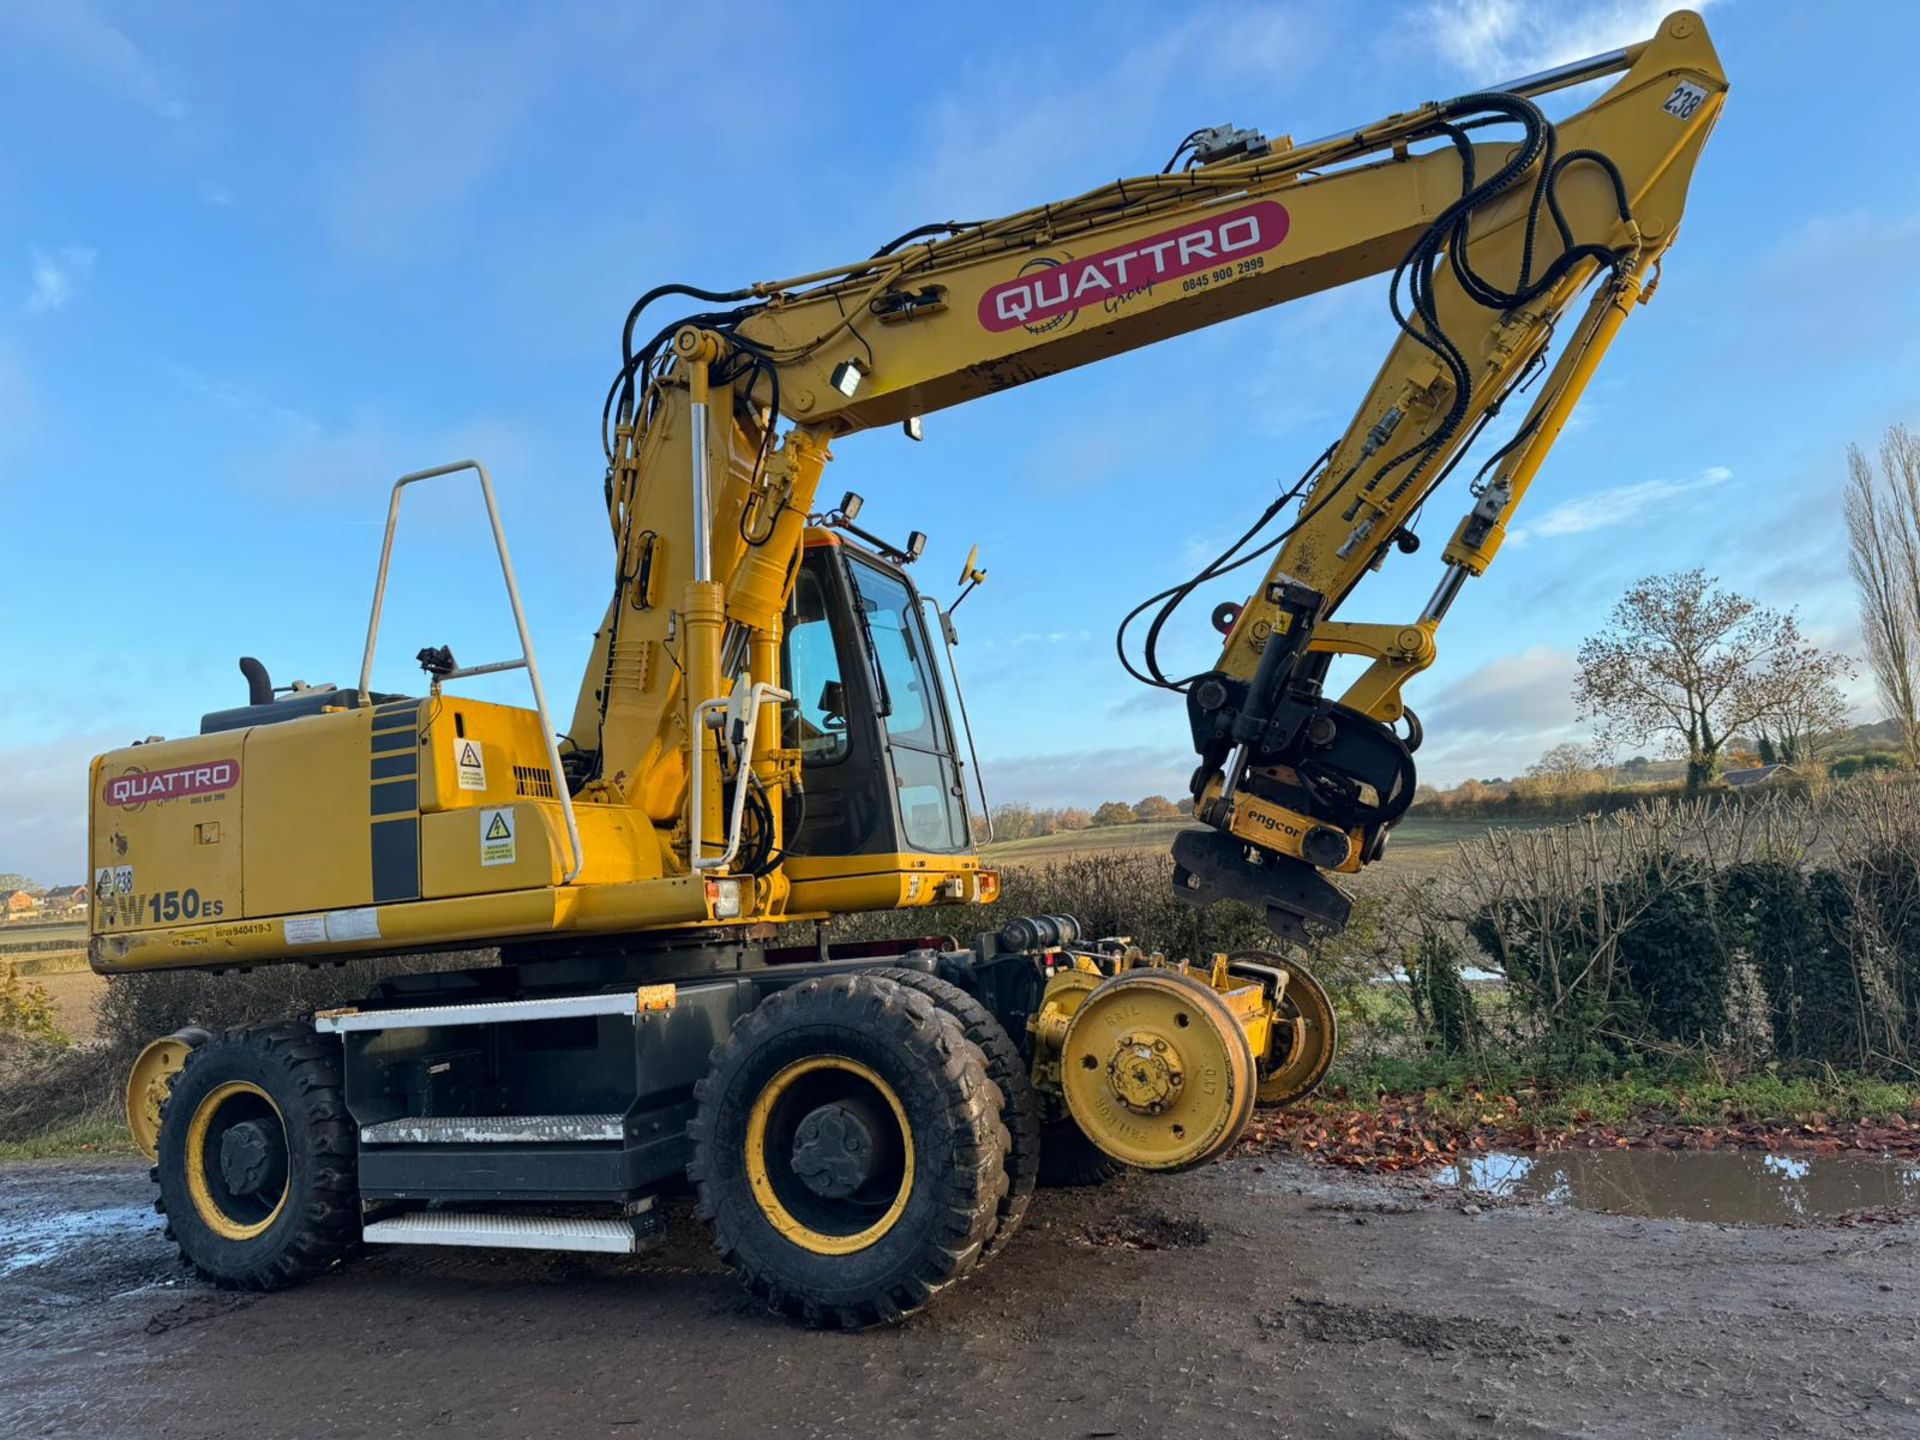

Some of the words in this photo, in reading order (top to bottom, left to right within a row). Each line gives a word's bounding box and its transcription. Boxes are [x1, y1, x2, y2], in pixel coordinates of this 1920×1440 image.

[1663, 87, 1702, 119] 238
[995, 215, 1261, 321] QUATTRO
[1182, 274, 1209, 292] 0845
[1212, 267, 1233, 282] 900
[1237, 256, 1265, 274] 2999
[1103, 280, 1156, 314] Group
[113, 765, 230, 802] QUATTRO
